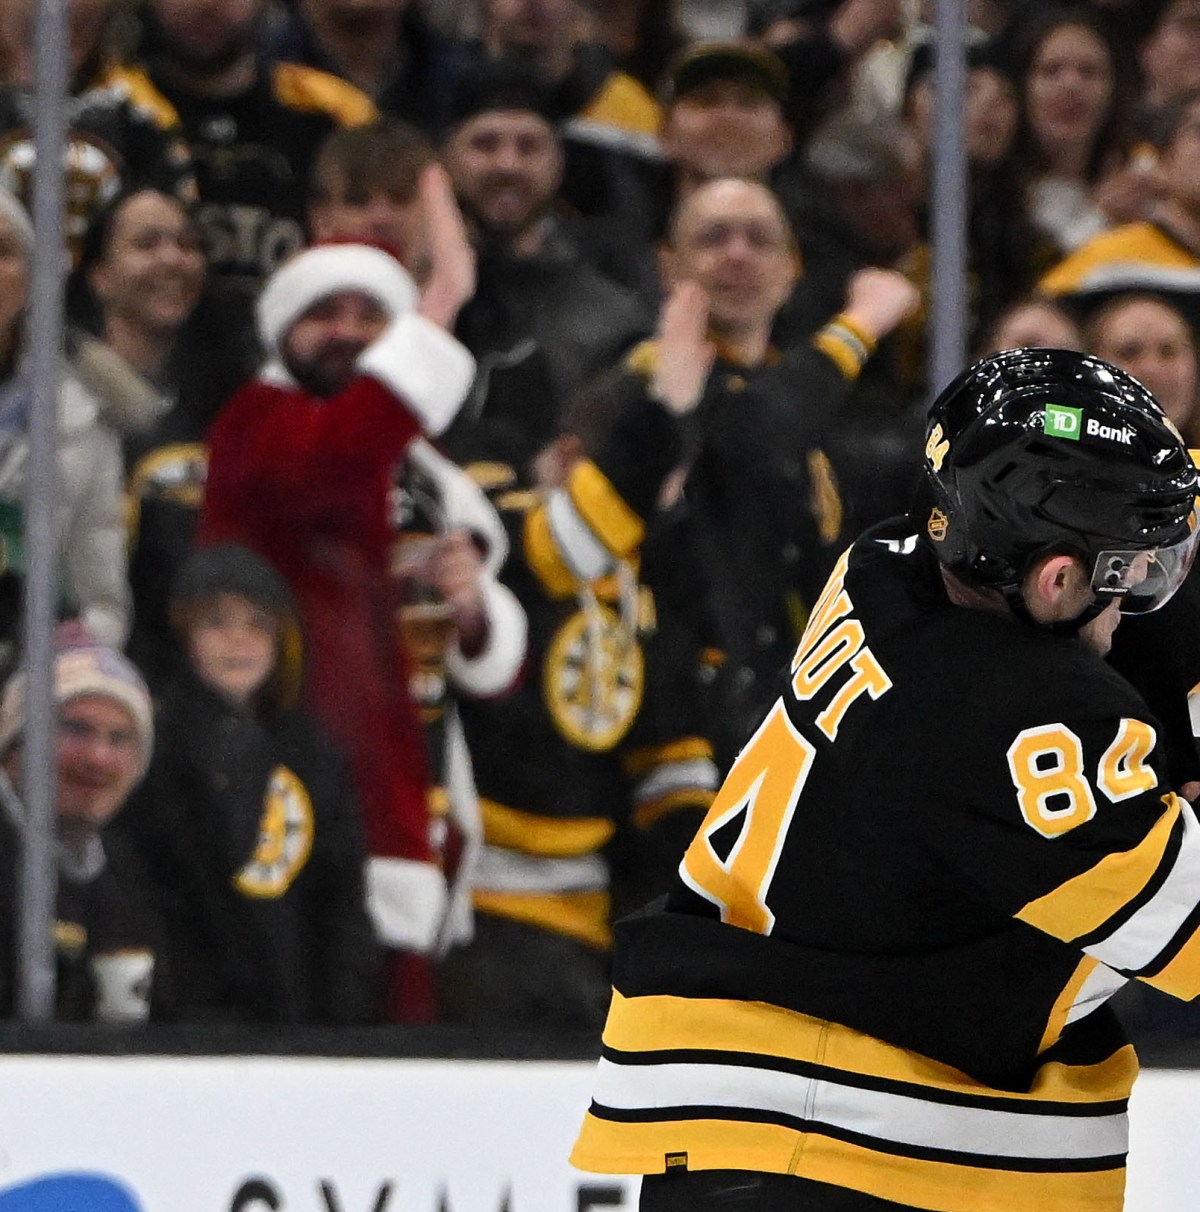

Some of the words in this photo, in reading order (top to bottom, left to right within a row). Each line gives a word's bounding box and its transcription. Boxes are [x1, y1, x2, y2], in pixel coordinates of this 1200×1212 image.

[1086, 418, 1137, 445] Bank
[791, 541, 893, 742] NOT
[1006, 717, 1158, 839] 84
